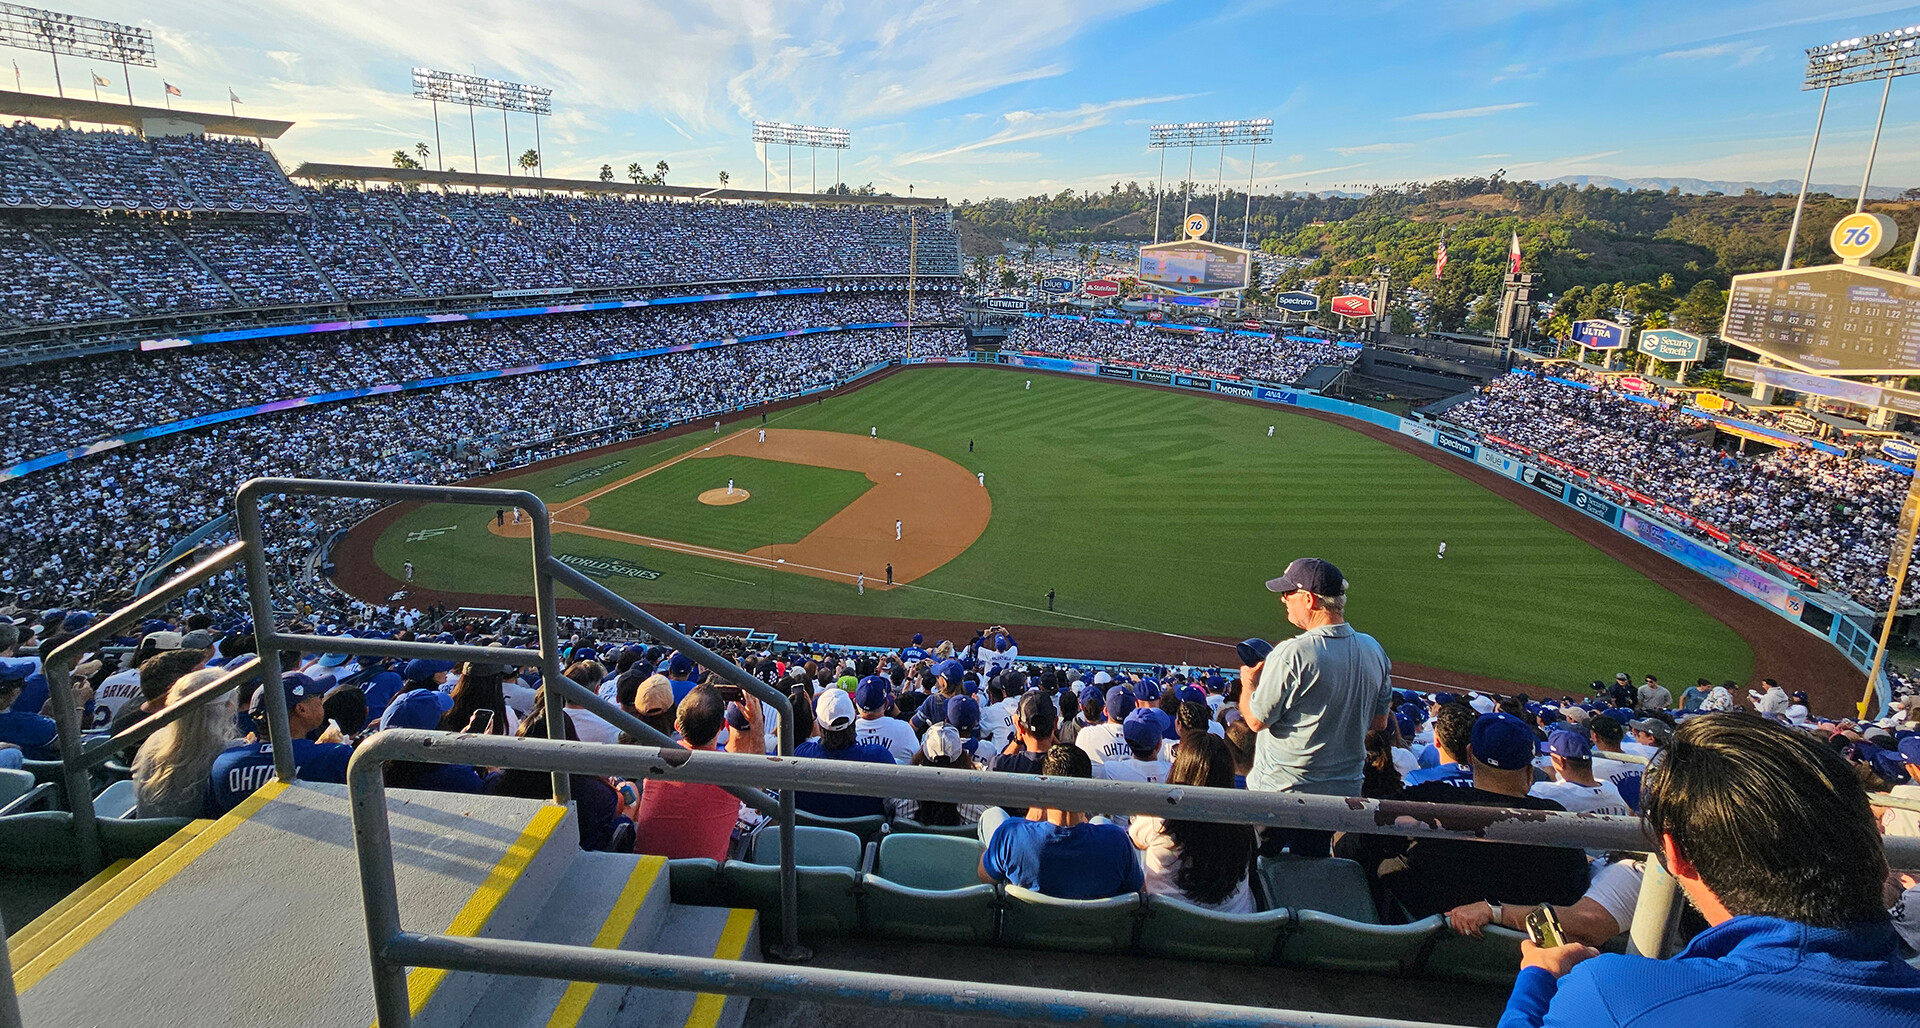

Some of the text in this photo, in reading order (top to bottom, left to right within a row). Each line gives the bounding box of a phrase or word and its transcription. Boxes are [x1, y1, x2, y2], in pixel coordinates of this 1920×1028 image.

[1190, 220, 1203, 231] 76
[1841, 225, 1872, 247] 76
[1043, 280, 1062, 289] blue
[989, 300, 1024, 309] CUTWATER
[1279, 297, 1312, 306] Spectrum
[1774, 299, 1787, 307] .310
[1849, 306, 1901, 319] 1-0 5.11 1.22
[1786, 317, 1799, 325] .452
[1803, 319, 1816, 327] .852
[1582, 327, 1611, 339] ULTRA
[1843, 323, 1891, 336] 12.1 11 4
[1660, 336, 1694, 349] Security
[1660, 345, 1687, 357] Benefit
[1220, 386, 1253, 397] MORTON
[1265, 390, 1284, 398] ANA
[1440, 434, 1471, 454] Spectrum
[1884, 440, 1919, 456] MORTON
[1485, 451, 1502, 466] blue
[1588, 497, 1609, 513] Security
[559, 554, 660, 580] WORLD SERIES
[1719, 562, 1770, 594] BASEBALL
[1788, 600, 1800, 612] 76
[1103, 742, 1134, 757] OHTA
